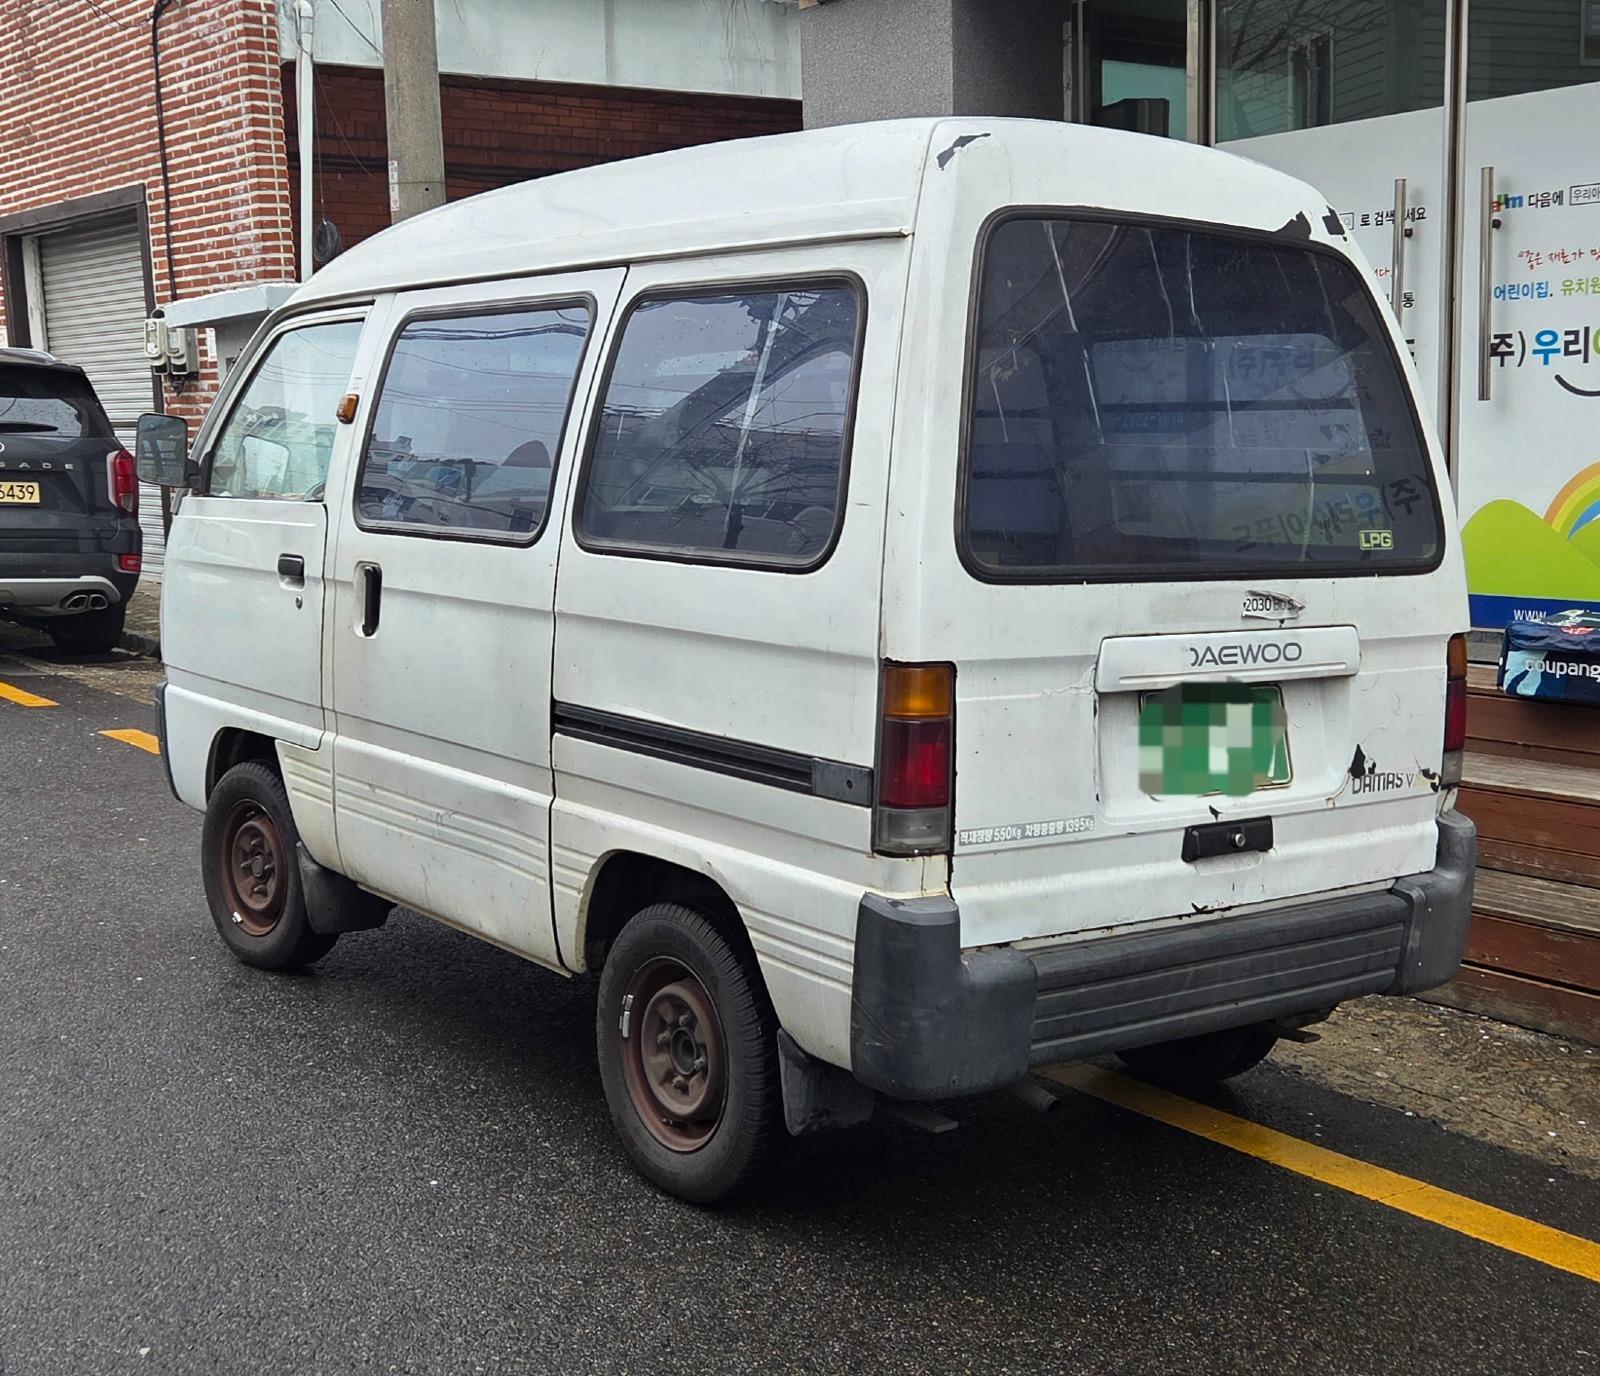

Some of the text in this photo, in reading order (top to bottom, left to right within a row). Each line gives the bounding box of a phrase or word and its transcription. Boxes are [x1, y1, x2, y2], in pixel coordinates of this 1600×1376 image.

[1528, 190, 1564, 208] 다음에
[1360, 213, 1371, 227] 로
[1374, 207, 1427, 226] 검색세요
[1360, 531, 1392, 548] LPG
[1525, 659, 1600, 683] coupang
[1352, 772, 1404, 795] DAMAS
